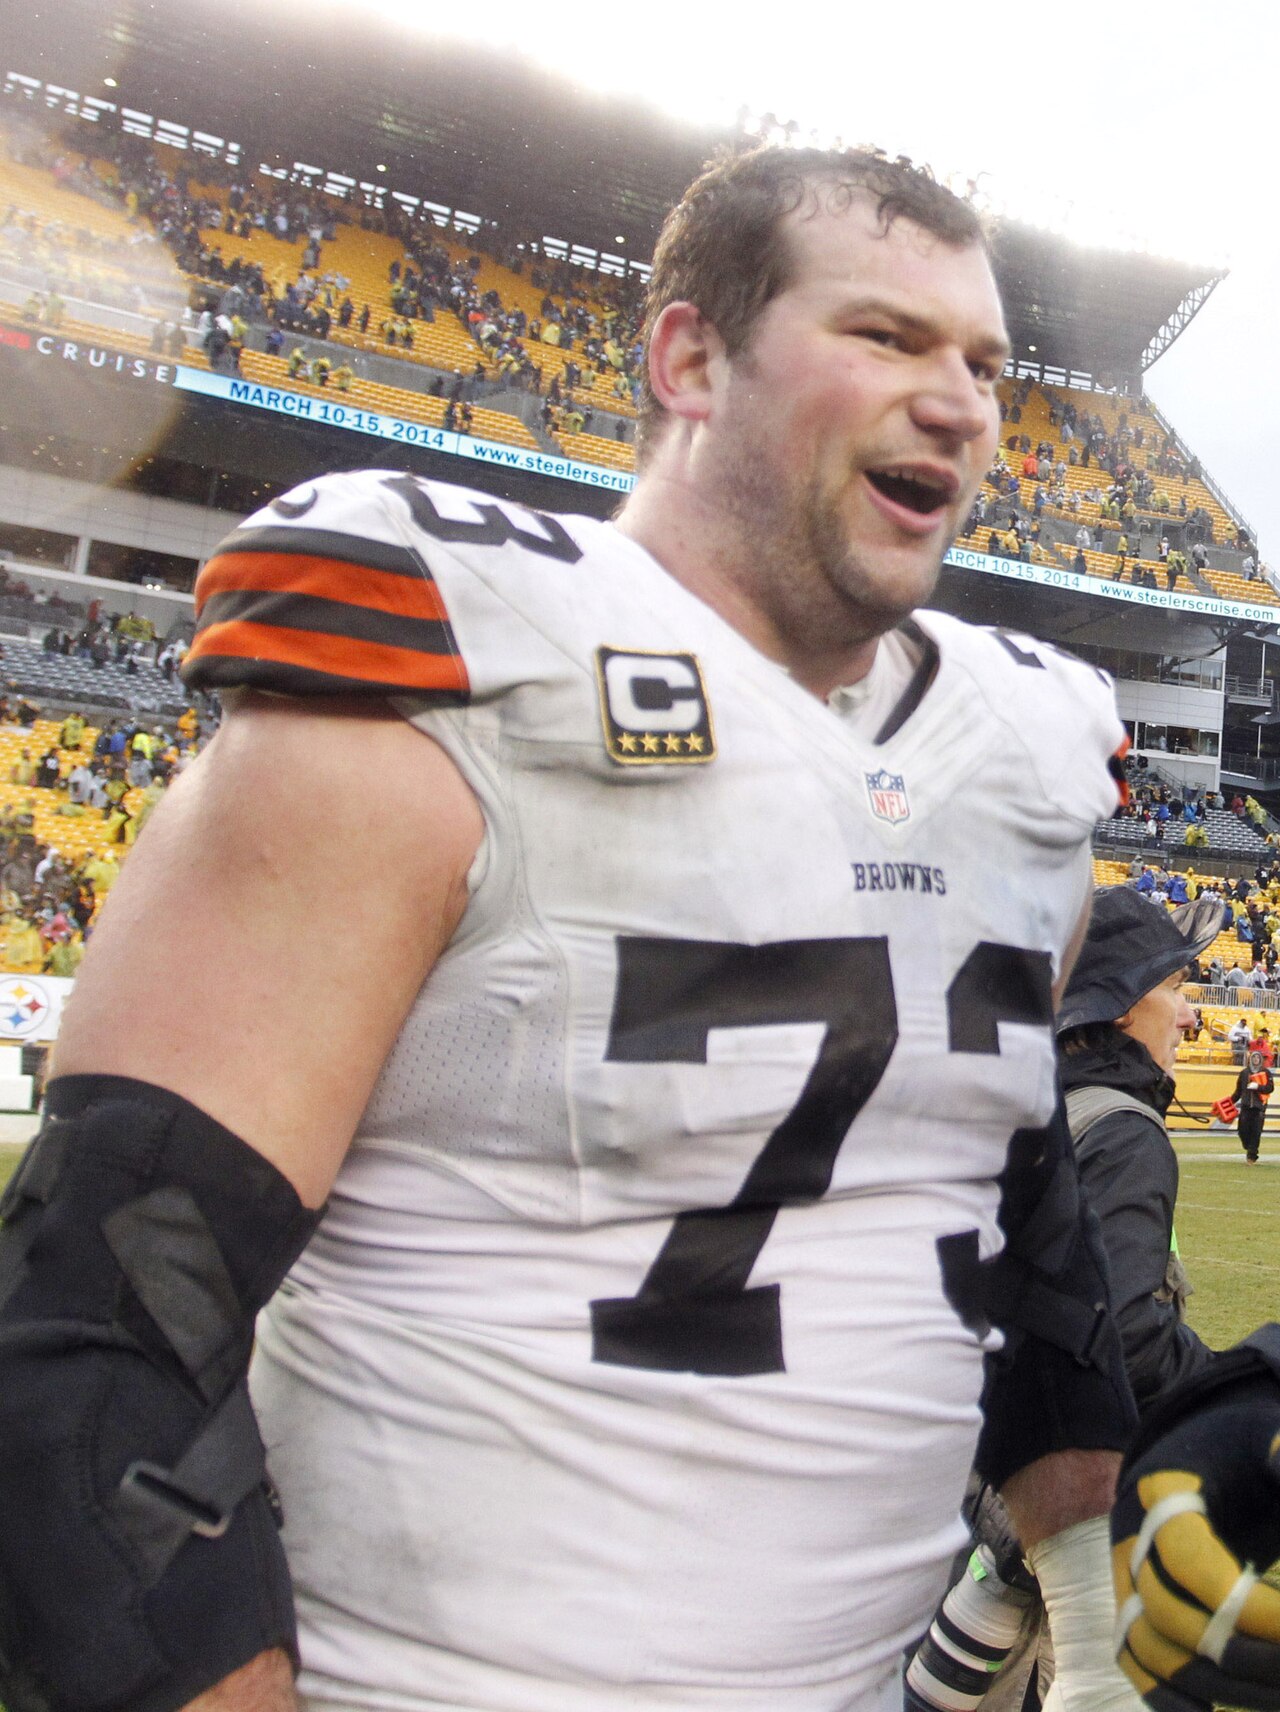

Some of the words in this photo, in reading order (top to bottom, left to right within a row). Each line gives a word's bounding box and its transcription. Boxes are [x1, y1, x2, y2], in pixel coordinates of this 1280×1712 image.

[230, 382, 312, 415] MARCH
[319, 405, 384, 435] 10-15,
[392, 422, 444, 447] 2014
[473, 444, 635, 490] www.steelerscrui
[944, 550, 986, 569] ARCH
[1044, 570, 1080, 588] 2014
[1100, 584, 1274, 621] www.steelerscruise.com
[605, 655, 701, 732] C
[872, 791, 907, 819] NFL
[851, 862, 946, 896] BROWNS
